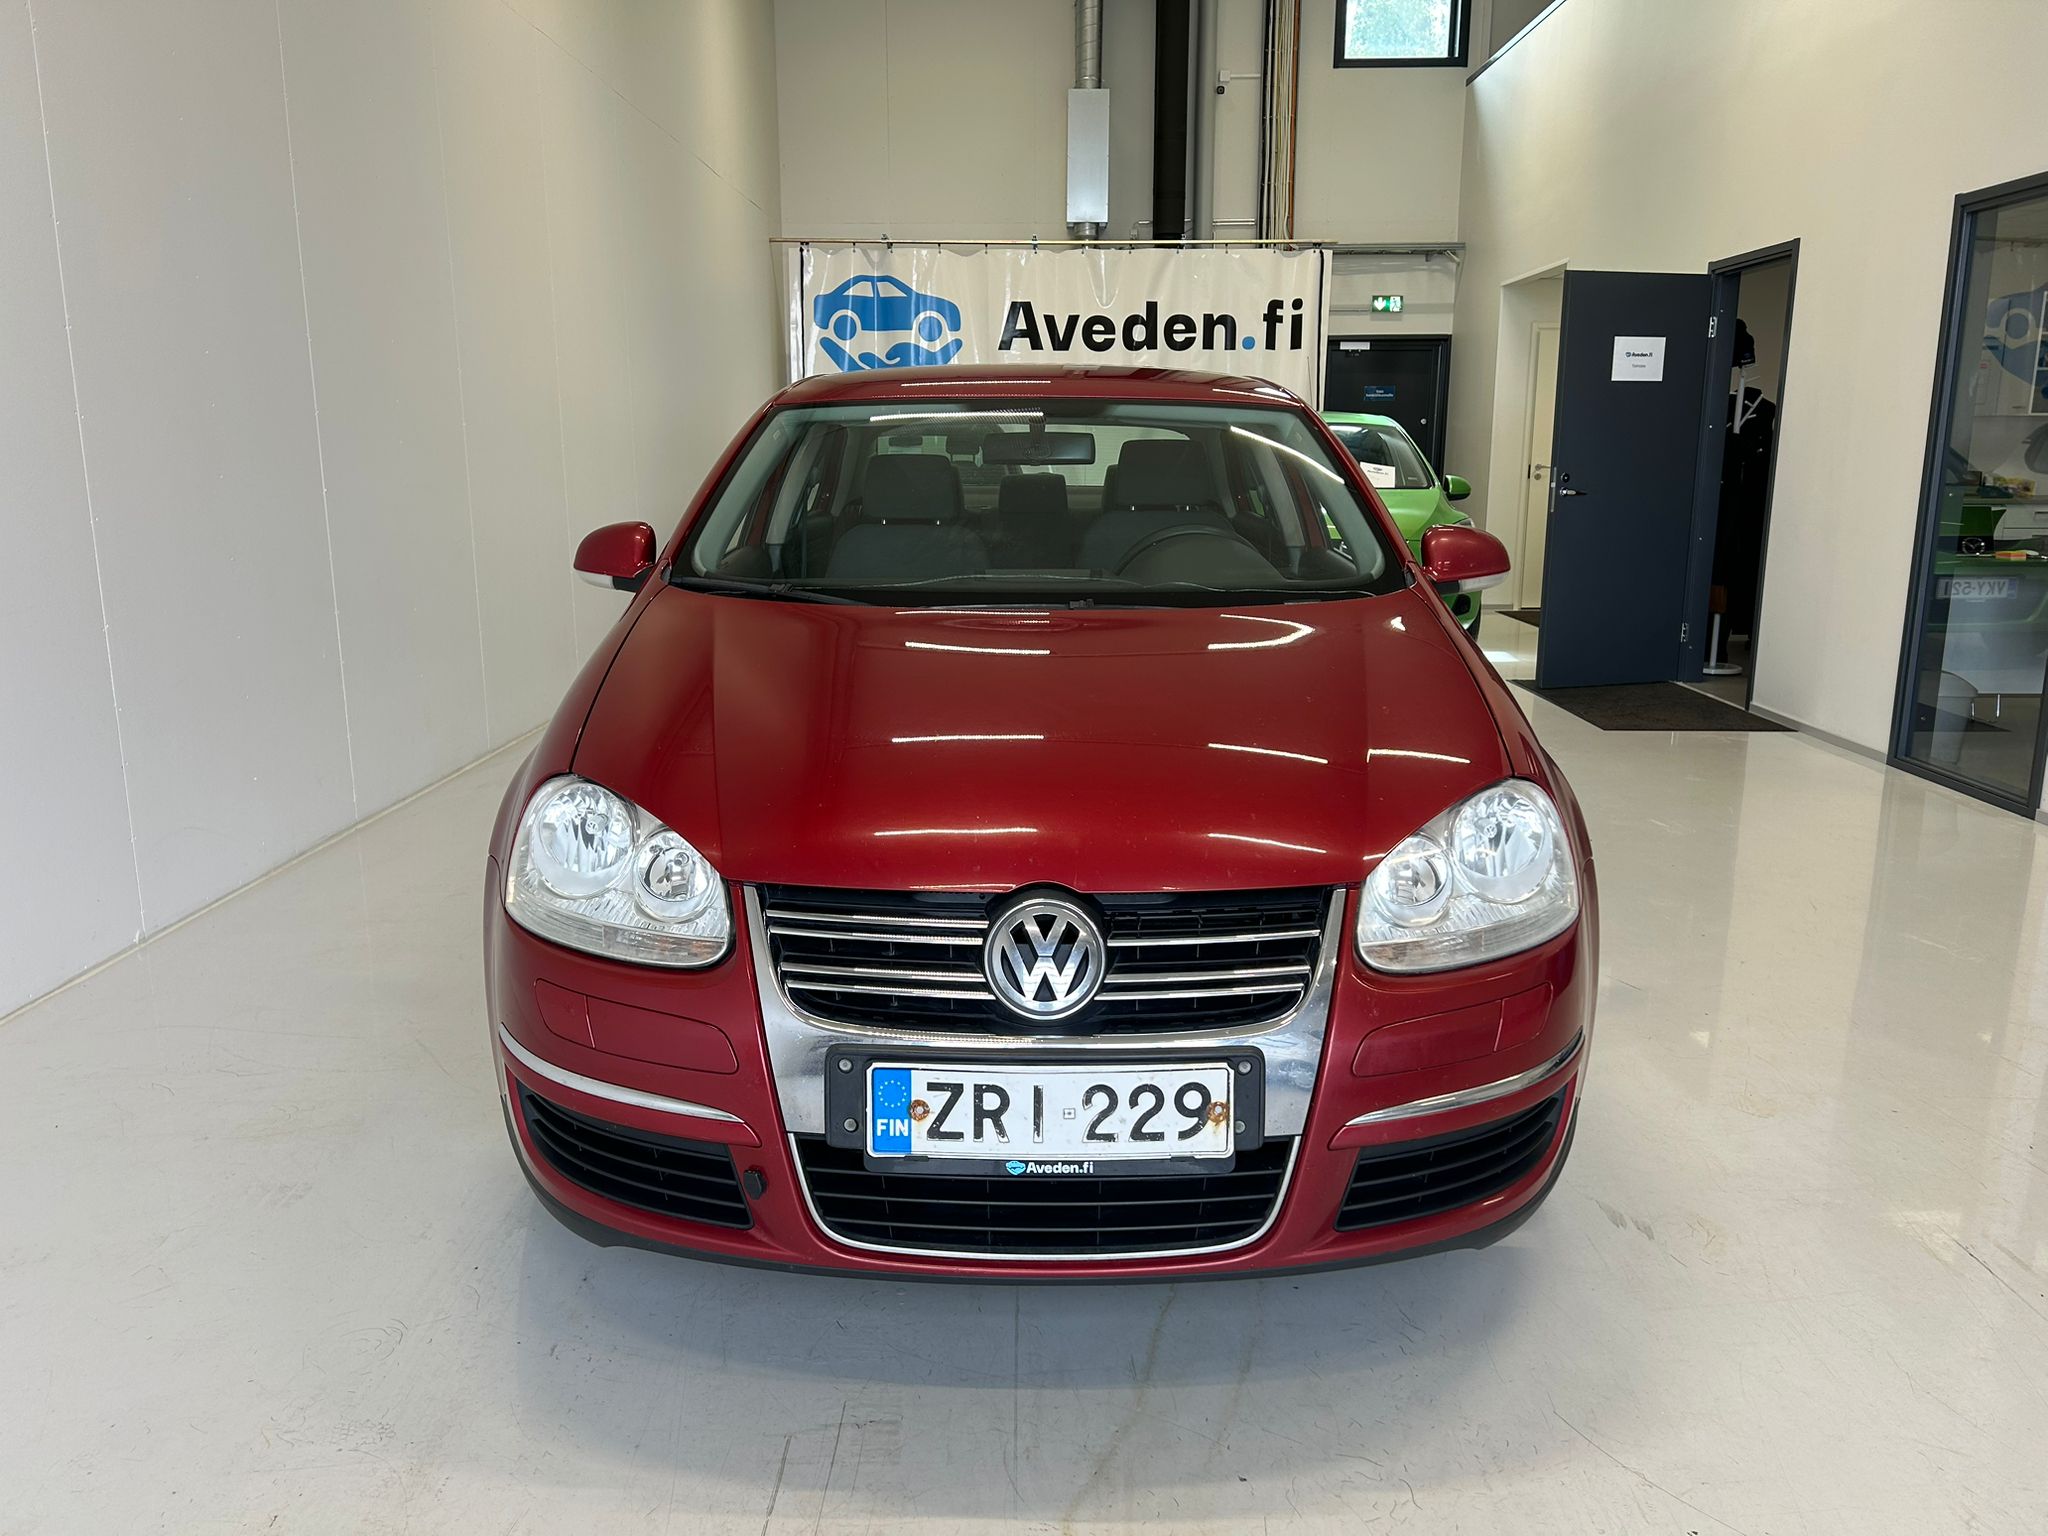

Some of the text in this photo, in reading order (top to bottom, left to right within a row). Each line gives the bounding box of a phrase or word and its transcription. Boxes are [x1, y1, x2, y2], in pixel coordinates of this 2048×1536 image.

[998, 298, 1304, 351] Aveden.fi
[877, 1118, 908, 1137] FIN
[1026, 1161, 1094, 1174] Aveden.fi
